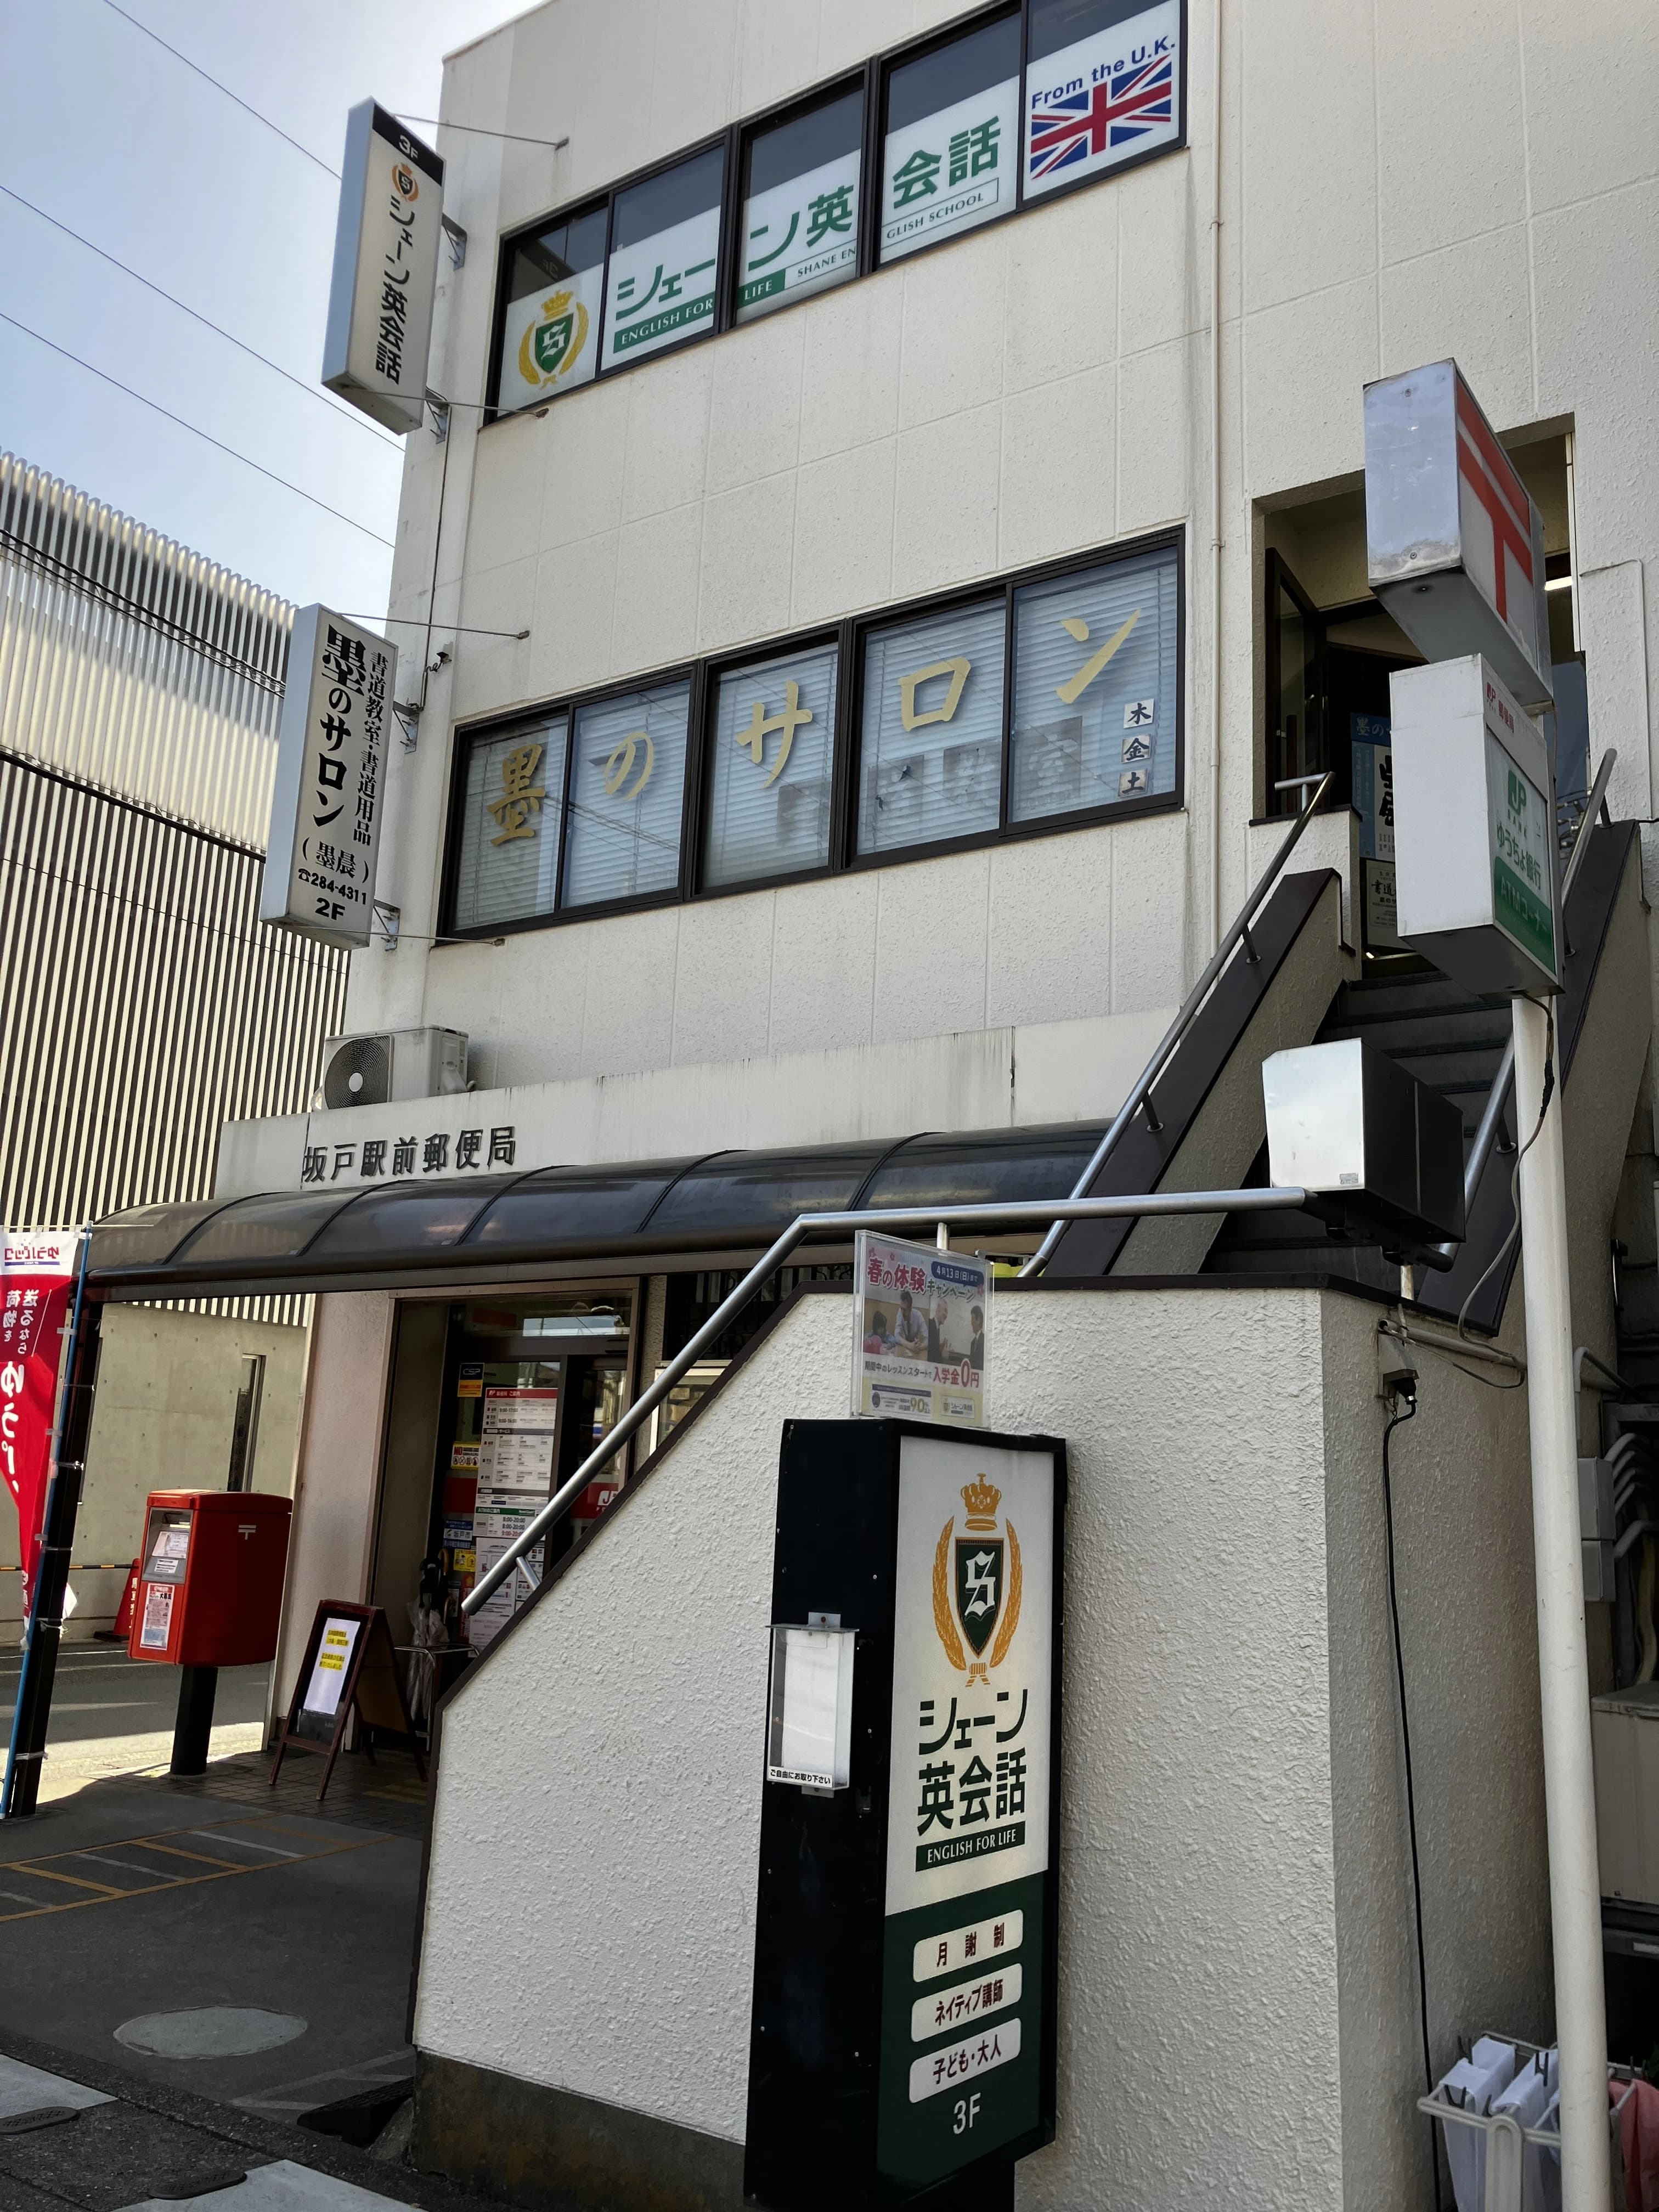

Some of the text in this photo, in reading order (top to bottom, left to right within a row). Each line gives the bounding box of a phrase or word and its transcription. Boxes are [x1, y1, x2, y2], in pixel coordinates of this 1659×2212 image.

[1031, 35, 1175, 110] From the U.K.
[399, 134, 418, 161] 3F
[797, 252, 837, 278] SHANE
[929, 192, 984, 223] SCHOOL
[375, 194, 415, 385] シェーン英会話
[621, 279, 772, 345] ENGLISH FOR LIFE
[313, 624, 365, 828] 墨のサロン
[352, 650, 388, 847] 書道教室・書道用品
[1356, 716, 1391, 737] 墨の
[1497, 821, 1541, 891] ゆうちょ銀行
[311, 872, 368, 905] 284-4311
[315, 896, 346, 921] 2F
[1500, 875, 1548, 932] ATMコーナー
[303, 1125, 516, 1183] 坂戸駅前郵便局
[867, 1257, 926, 1294] 春の体験
[927, 1278, 975, 1302] キャンペーン
[933, 1359, 980, 1389] 入学金0円
[918, 1688, 1029, 1756] シェーン
[770, 1767, 832, 1786] ご自由にお取り下さい
[917, 1746, 1027, 1836] 英会話
[927, 1828, 1017, 1864] ENGLISH FOR LIFE
[935, 1978, 1004, 2027] ネイティブ講師
[933, 2033, 1002, 2085] 子ども・大人
[952, 2092, 981, 2136] 3F
